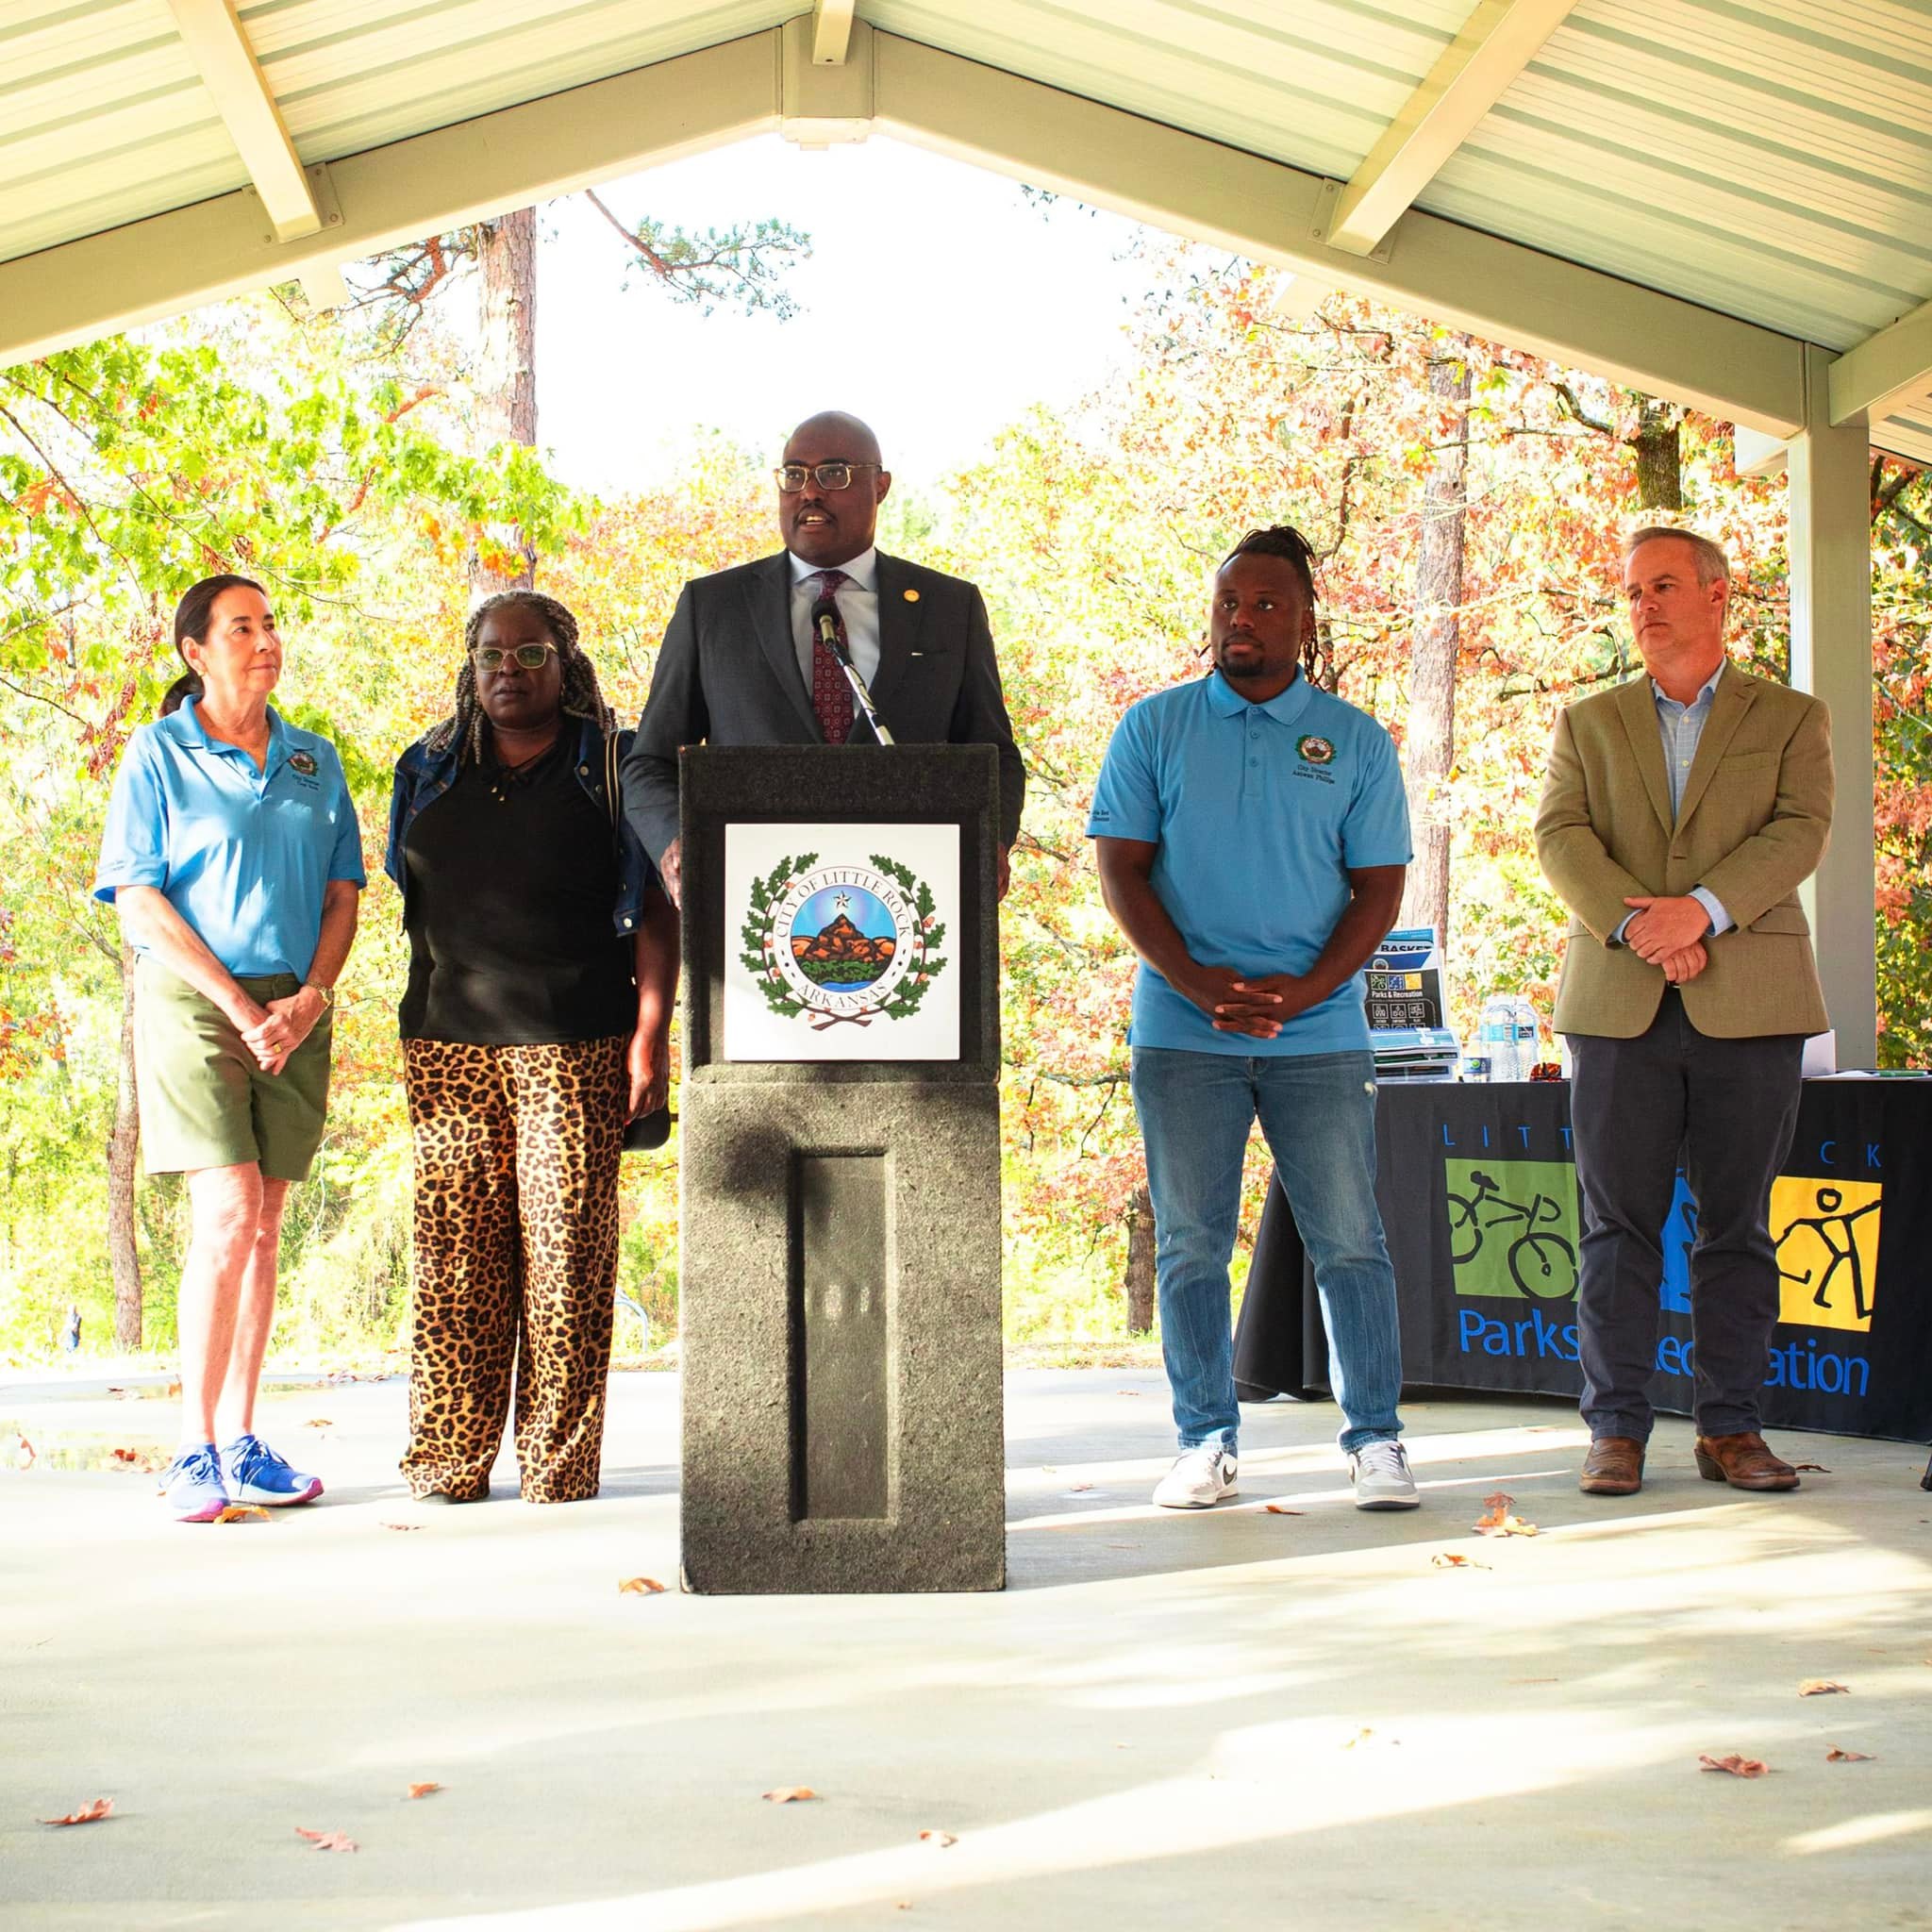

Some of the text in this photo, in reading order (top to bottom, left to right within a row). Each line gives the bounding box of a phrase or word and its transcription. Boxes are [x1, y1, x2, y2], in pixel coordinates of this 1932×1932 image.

[776, 871, 912, 939] CITY OF LITTLE ROCK
[798, 982, 888, 1008] ARKANSAS
[1443, 1124, 1882, 1168] LITT CK
[1458, 1308, 1580, 1361] Parks
